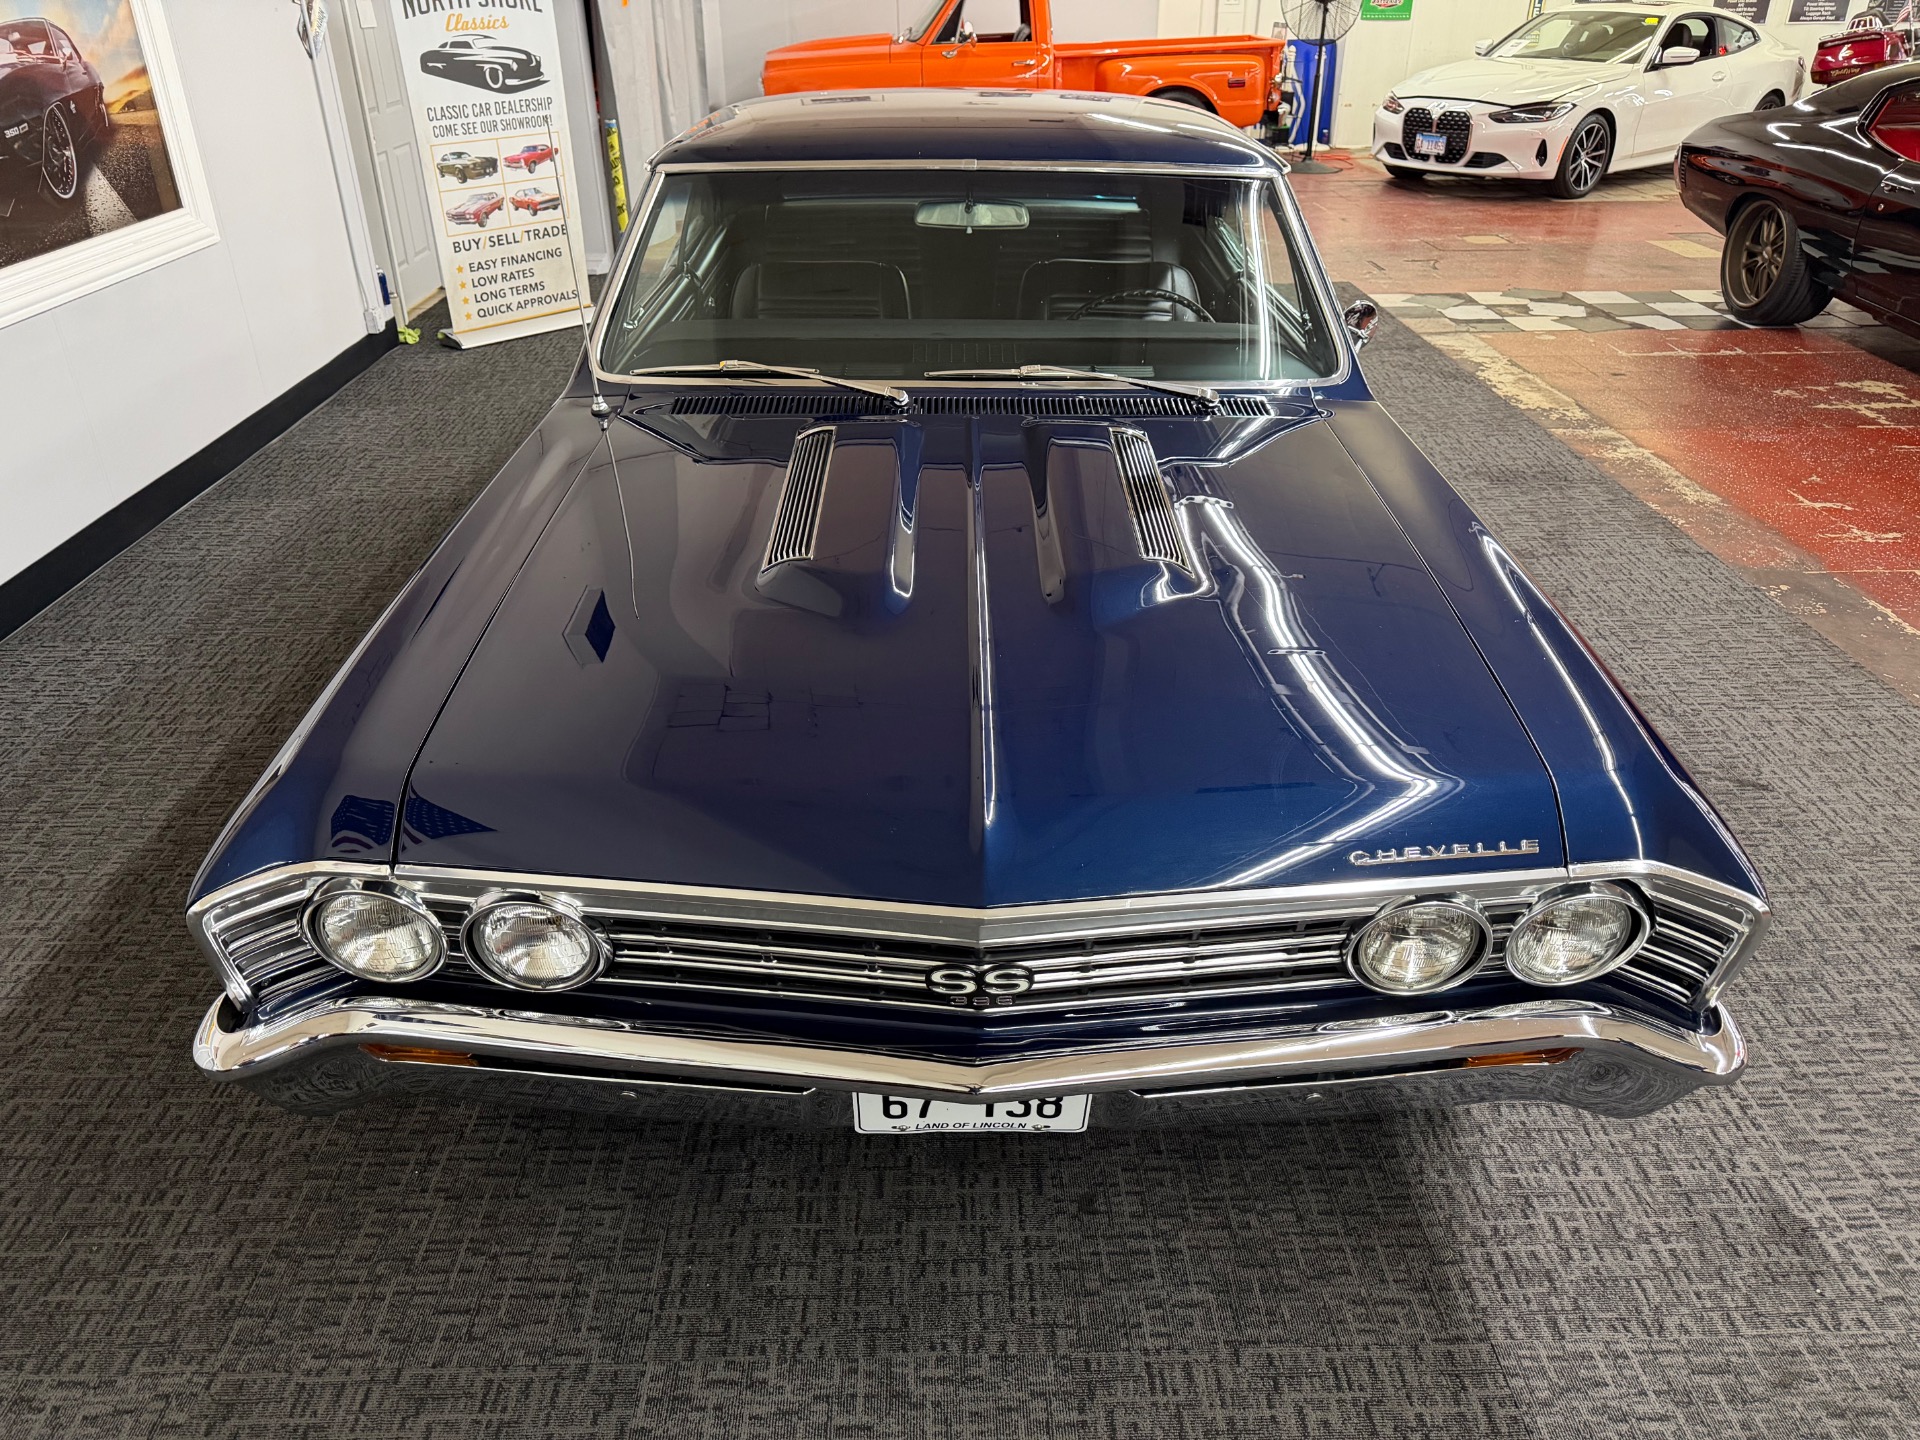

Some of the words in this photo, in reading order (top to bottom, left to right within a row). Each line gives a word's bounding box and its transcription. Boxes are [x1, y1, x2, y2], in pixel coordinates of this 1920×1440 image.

[445, 13, 509, 32] Classics
[427, 104, 469, 121] CLASSIC
[472, 102, 492, 117] CAR
[494, 97, 553, 115] DEALERSHIP
[432, 123, 459, 138] COME
[461, 121, 478, 135] SEE
[480, 119, 499, 133] OUR
[500, 115, 553, 131] SHOWROOM!
[468, 258, 498, 273] EASY
[500, 247, 562, 267] FINANCING
[471, 274, 498, 288] LOW
[501, 267, 535, 283] RATES
[474, 288, 507, 303] LONG
[508, 281, 545, 297] TERMS
[477, 304, 514, 318] QUICK
[516, 289, 578, 311] APPROVALS
[1349, 839, 1540, 866] CHEVELLE
[929, 969, 1031, 995] SS
[915, 1122, 950, 1130] LAND
[972, 1121, 1027, 1129] LINCOLN
